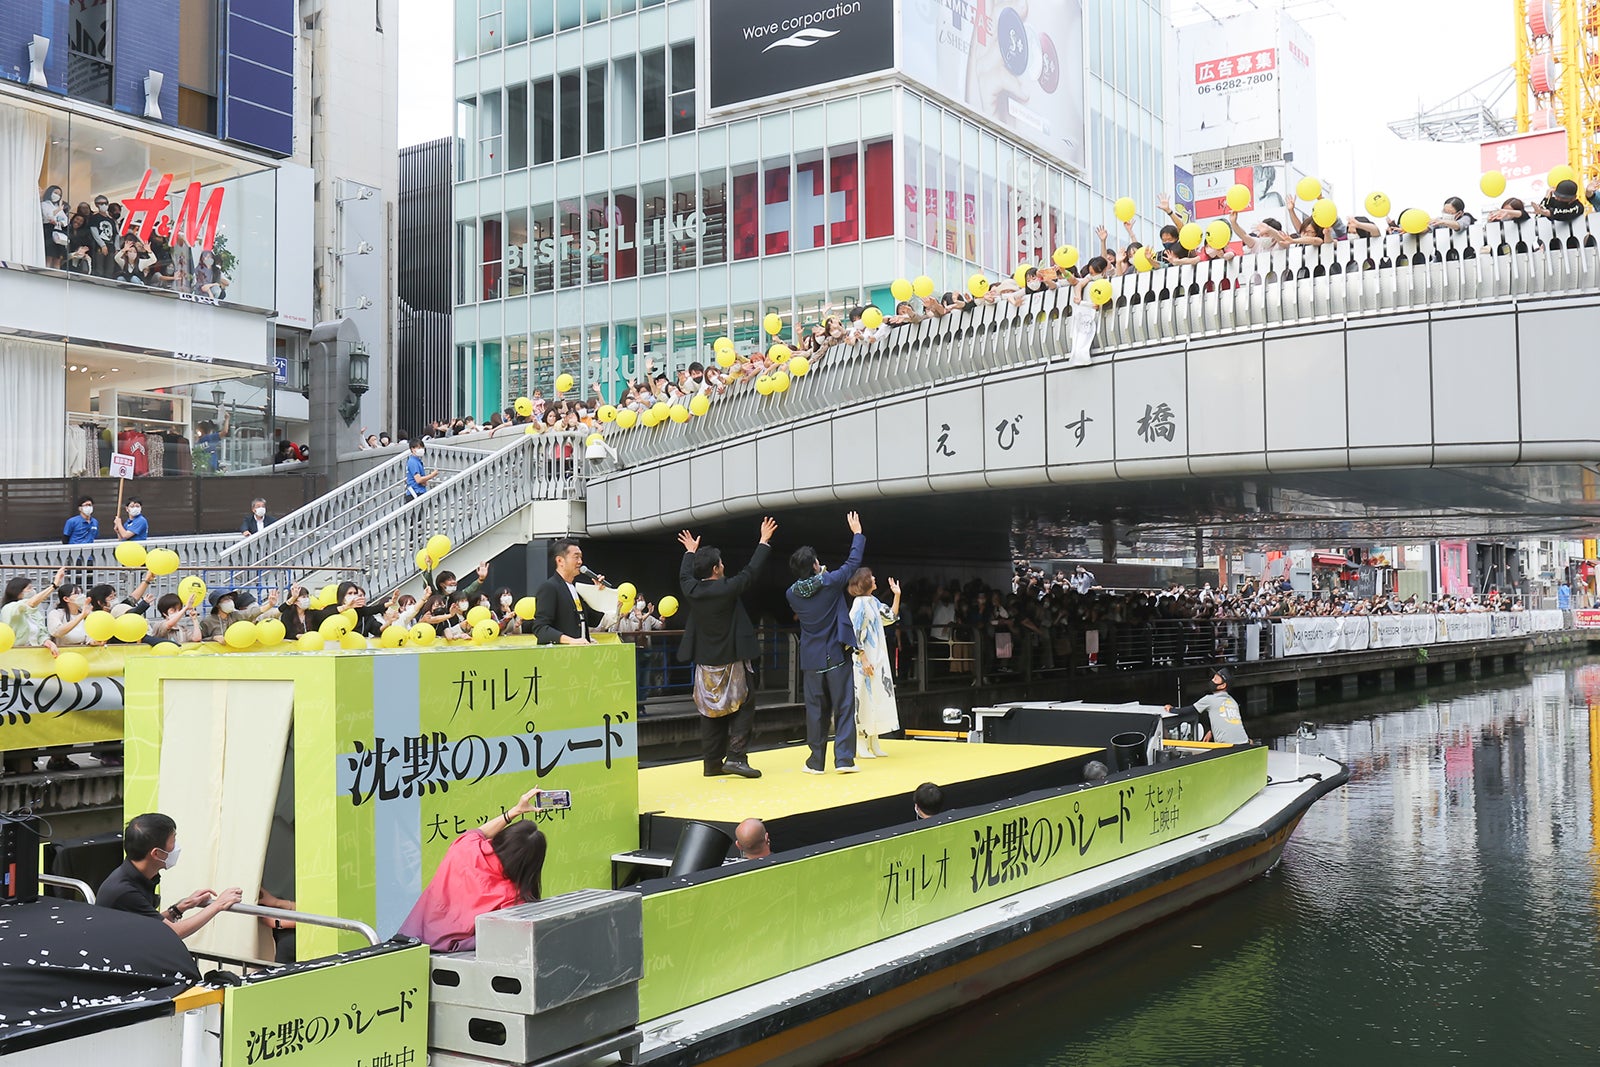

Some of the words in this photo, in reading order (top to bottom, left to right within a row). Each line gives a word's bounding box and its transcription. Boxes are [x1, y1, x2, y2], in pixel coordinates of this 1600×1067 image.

[743, 22, 779, 41] Wave
[781, 1, 861, 28] corporation
[1197, 72, 1274, 95] 06-6282-7800
[1198, 51, 1273, 82] 広告募集
[120, 168, 225, 252] H&M
[507, 234, 574, 270] BEST
[580, 211, 708, 258] SELLING
[936, 402, 1176, 457] えびす橋
[449, 666, 542, 725] ガリレオ
[347, 711, 630, 806] 沈黙のパレード
[1144, 778, 1184, 812] 大ヒット
[1149, 804, 1181, 836] 上映中
[969, 786, 1135, 893] 沈黙のパレード
[880, 848, 951, 920] ガリレオ
[245, 987, 419, 1066] 沈黙のパレード
